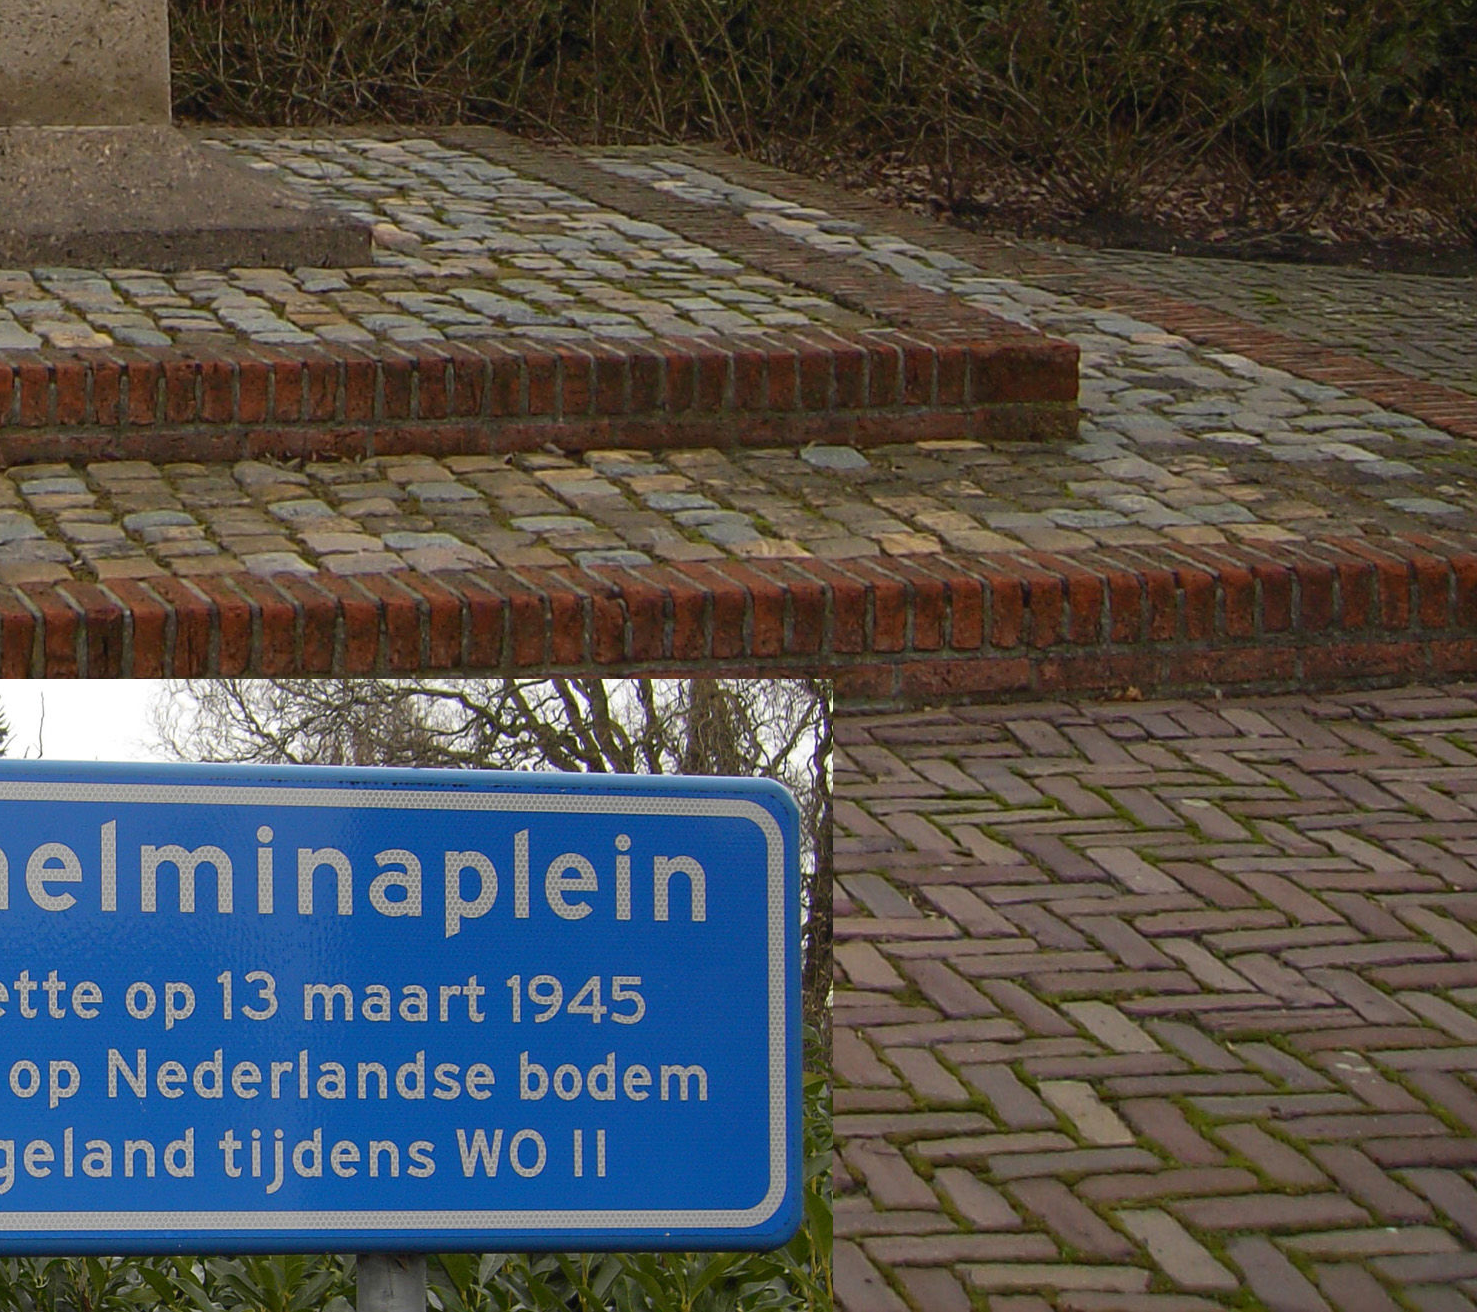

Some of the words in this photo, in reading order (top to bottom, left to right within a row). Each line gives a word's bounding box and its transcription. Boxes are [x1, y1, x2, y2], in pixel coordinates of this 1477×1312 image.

[126, 982, 195, 1030] op
[218, 971, 277, 1020] 13
[304, 976, 484, 1022] maart
[507, 975, 645, 1024] 1945
[10, 1060, 80, 1108] op
[108, 1049, 495, 1099] Nederlandse
[520, 1051, 707, 1100] bodem
[219, 1128, 435, 1193] tijdens
[457, 1129, 546, 1177] WO
[574, 1130, 605, 1176] II
